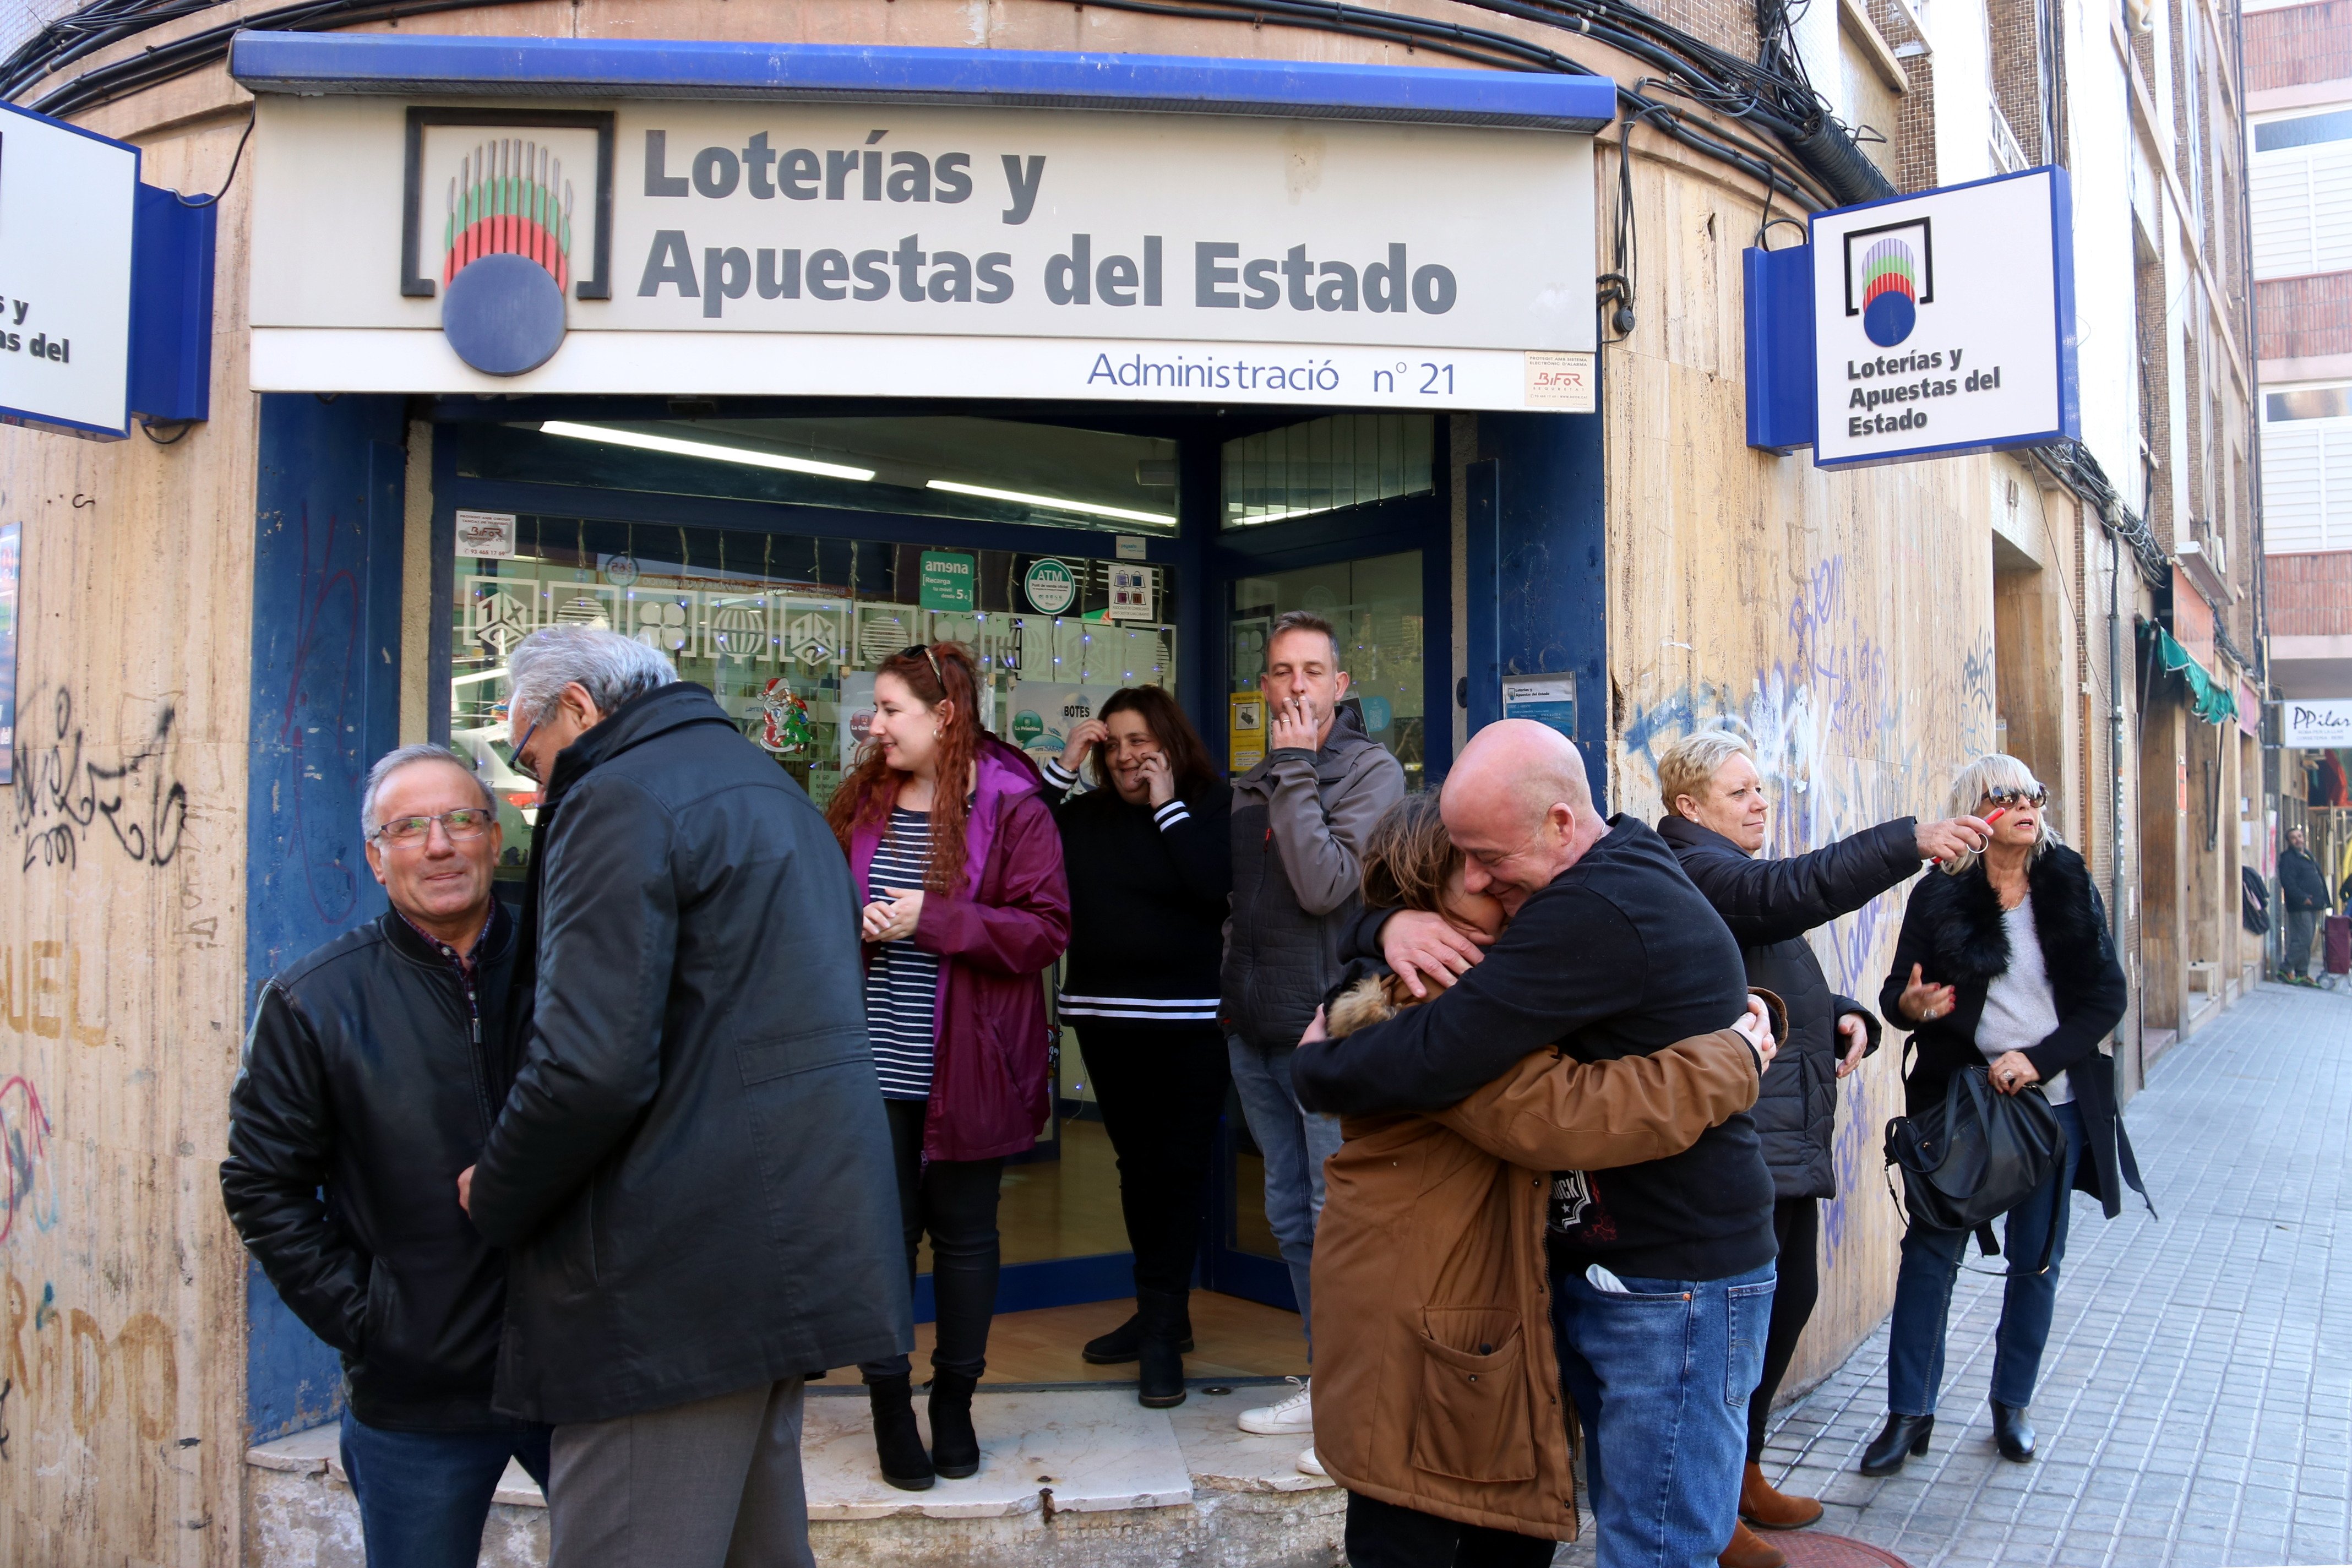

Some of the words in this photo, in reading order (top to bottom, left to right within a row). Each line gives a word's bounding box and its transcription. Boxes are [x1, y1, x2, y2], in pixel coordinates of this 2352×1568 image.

[644, 129, 973, 203] Loterías
[1000, 154, 1046, 225] y
[636, 229, 1014, 318] Apuestas
[1043, 233, 1162, 307] del
[1194, 241, 1457, 315] Estado
[13, 299, 29, 325] y
[29, 332, 69, 364] del
[1847, 349, 1942, 380] Loterías
[1949, 348, 1963, 371] y
[1087, 352, 1340, 392] Administració
[1418, 362, 1454, 395] 21
[1849, 377, 1957, 411] Apuestas
[1964, 366, 2001, 393] del
[1848, 407, 1928, 437] Estado
[1036, 569, 1063, 582] ATM
[956, 589, 964, 600] 5
[1064, 705, 1090, 718] BOTES
[0, 939, 107, 1048] UEL
